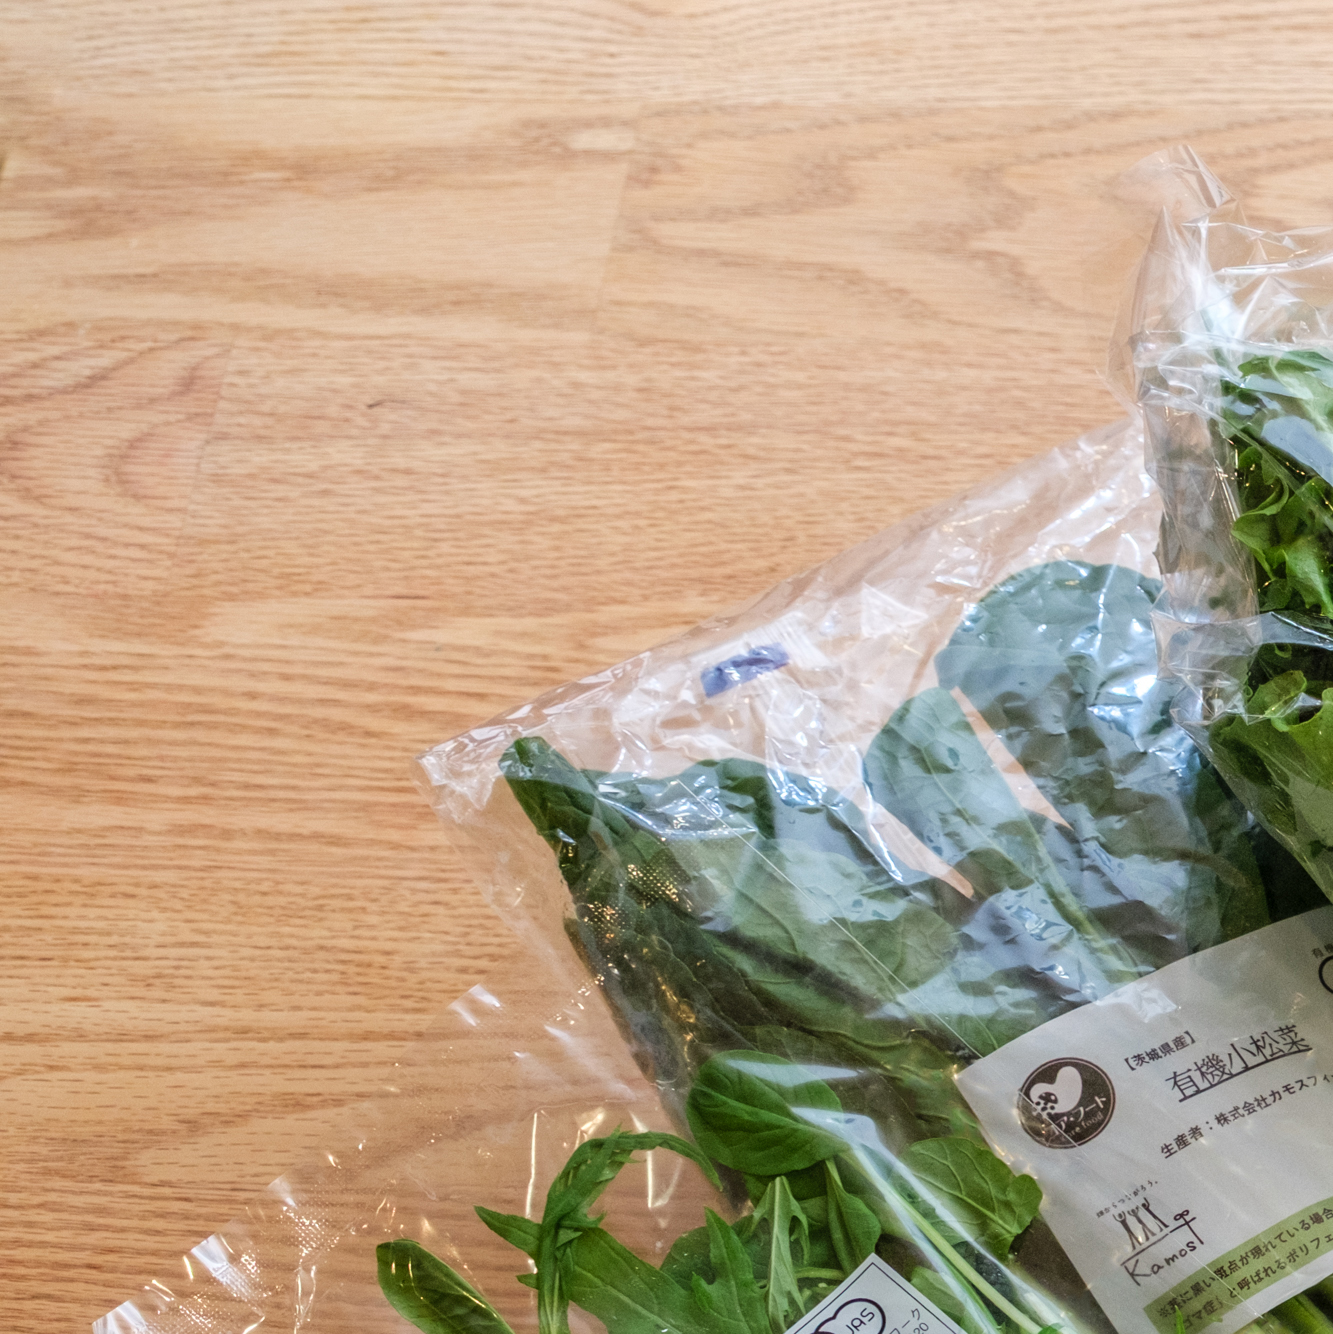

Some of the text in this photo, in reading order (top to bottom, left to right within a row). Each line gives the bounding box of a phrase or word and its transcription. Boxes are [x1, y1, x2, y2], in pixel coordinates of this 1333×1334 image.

[1124, 1031, 1195, 1071] 【茨城県産】
[1165, 1017, 1308, 1100] 有機小松菜
